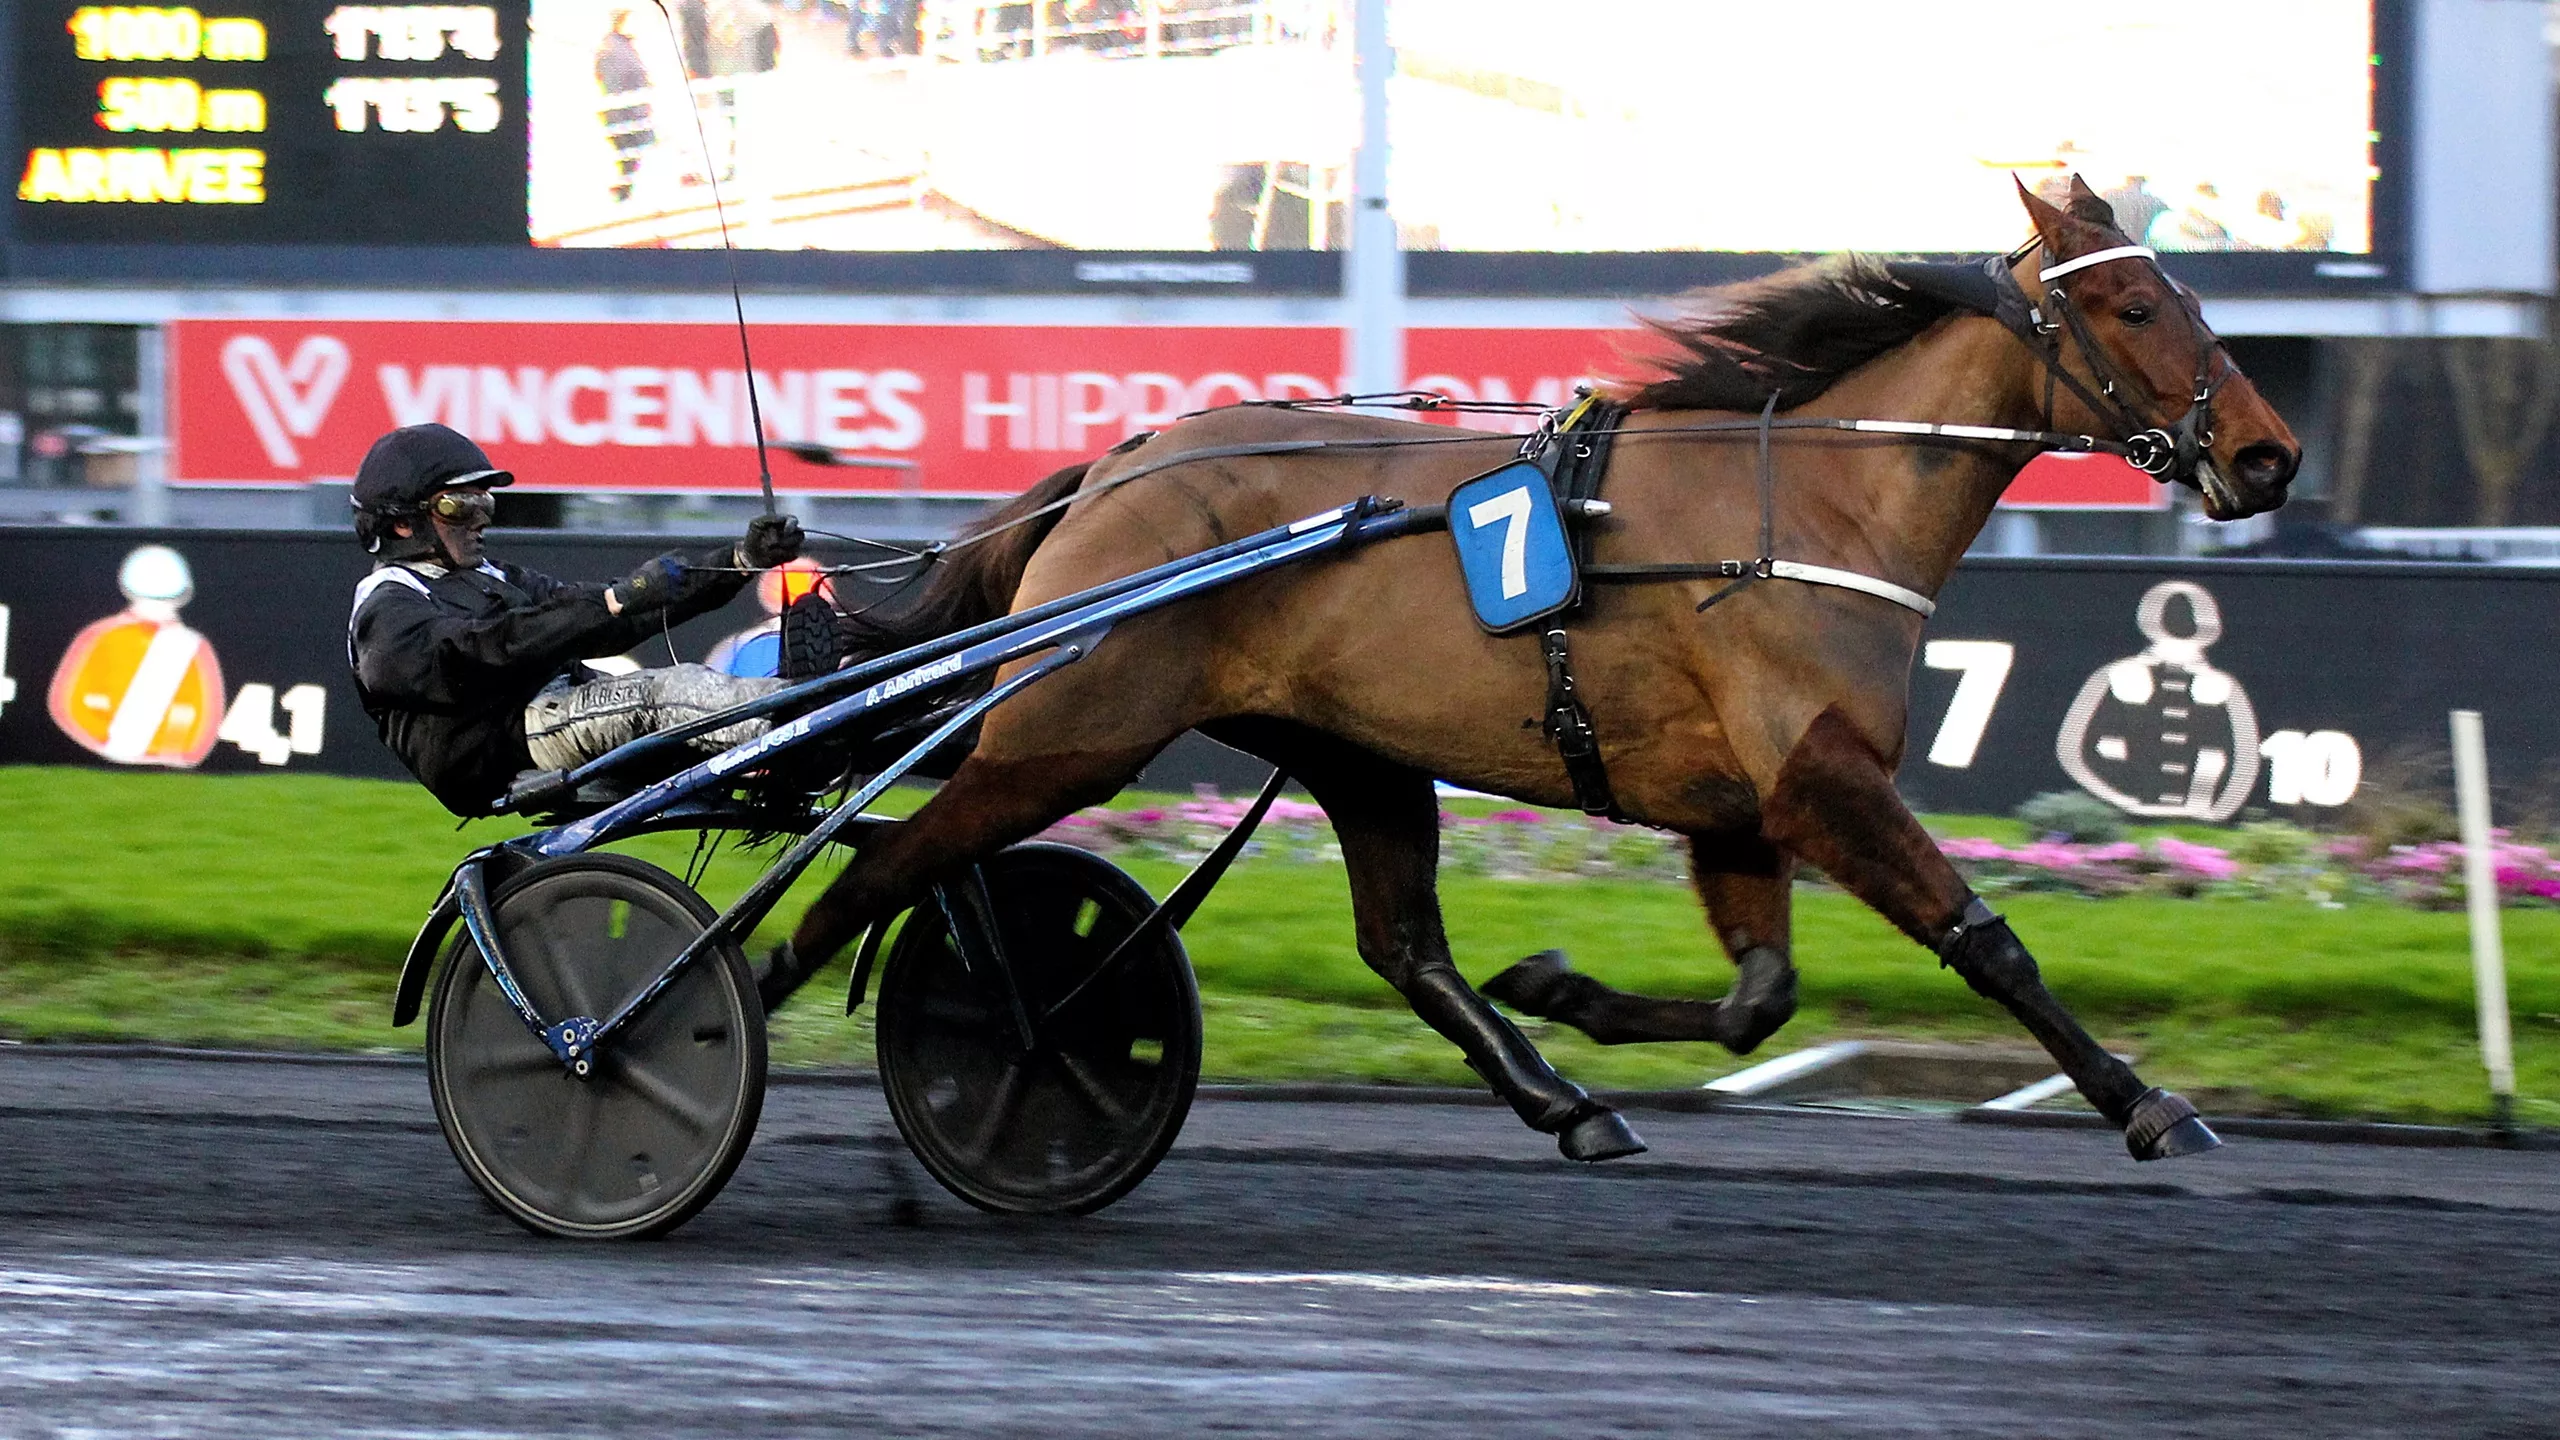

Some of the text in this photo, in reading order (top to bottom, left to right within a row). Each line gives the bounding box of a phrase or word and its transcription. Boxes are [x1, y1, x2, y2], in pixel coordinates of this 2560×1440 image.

[67, 6, 201, 61] 1000
[202, 17, 267, 61] m
[95, 77, 201, 132] 500
[202, 89, 267, 132] m
[377, 364, 926, 451] VINCENNES
[1469, 485, 1532, 600] 7
[883, 653, 962, 700] Abrivard
[1924, 640, 2014, 768] 7
[2260, 730, 2362, 806] 10
